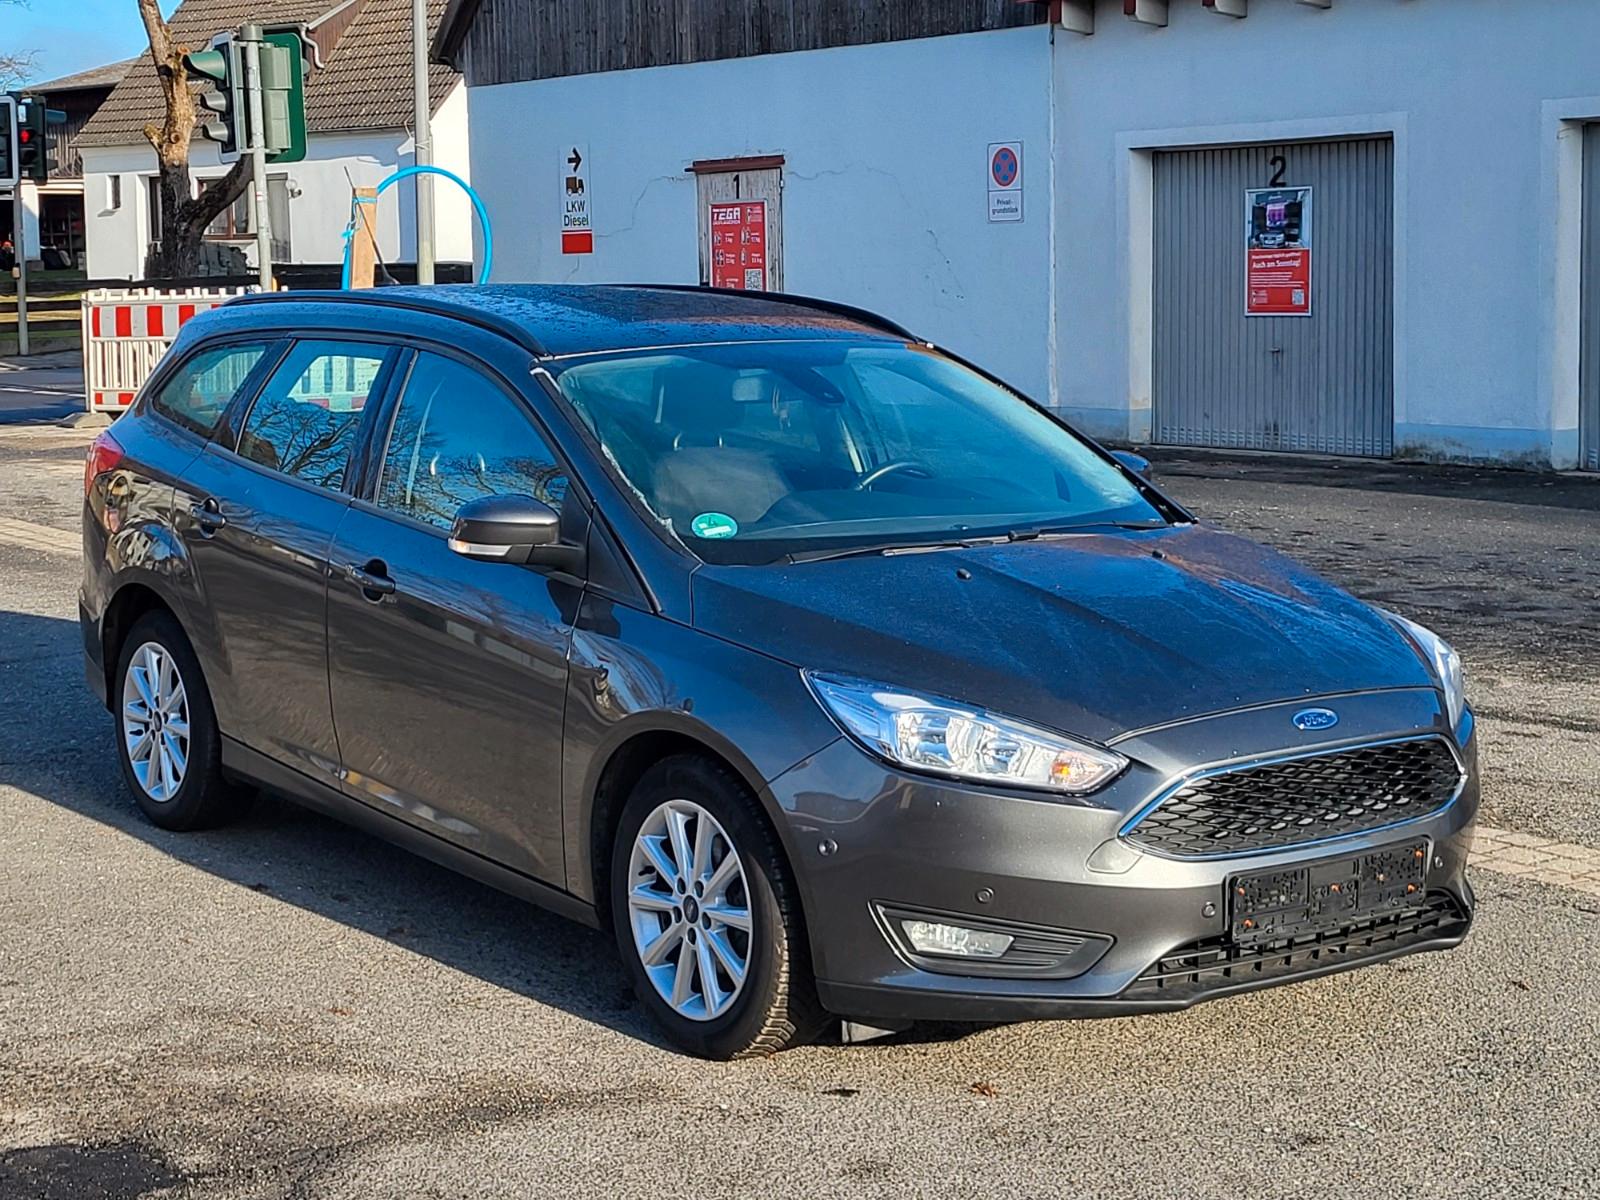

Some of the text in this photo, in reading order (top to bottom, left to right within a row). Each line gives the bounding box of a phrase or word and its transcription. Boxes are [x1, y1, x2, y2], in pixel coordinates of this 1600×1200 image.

[1269, 155, 1287, 187] 2
[733, 174, 740, 199] 1
[566, 201, 585, 212] LKW
[712, 207, 741, 220] TEGA
[564, 214, 589, 226] Diesel
[1304, 714, 1327, 725] Ford
